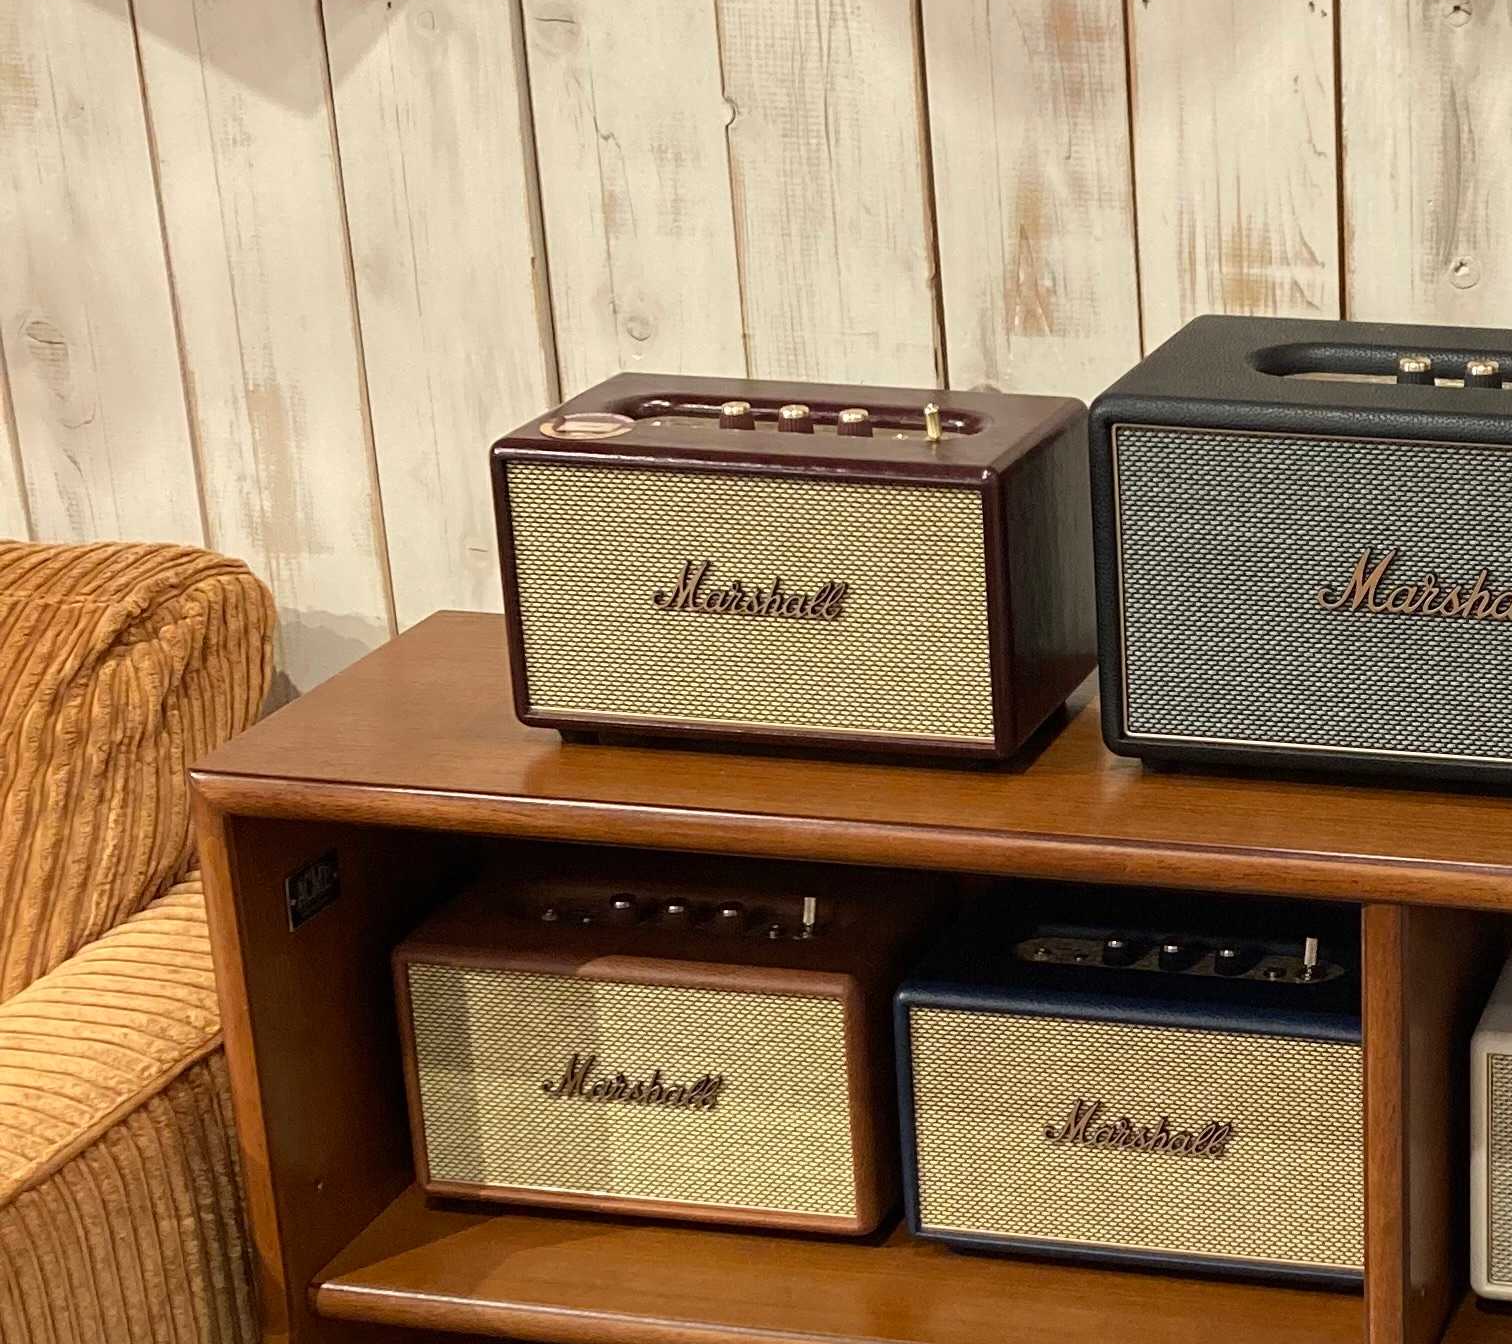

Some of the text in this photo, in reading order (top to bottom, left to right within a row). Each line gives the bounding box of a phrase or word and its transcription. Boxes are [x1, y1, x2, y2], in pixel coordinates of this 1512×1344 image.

[652, 558, 848, 622] Marshall
[543, 1053, 723, 1110] Marshall
[1043, 1098, 1234, 1157] Marshall
